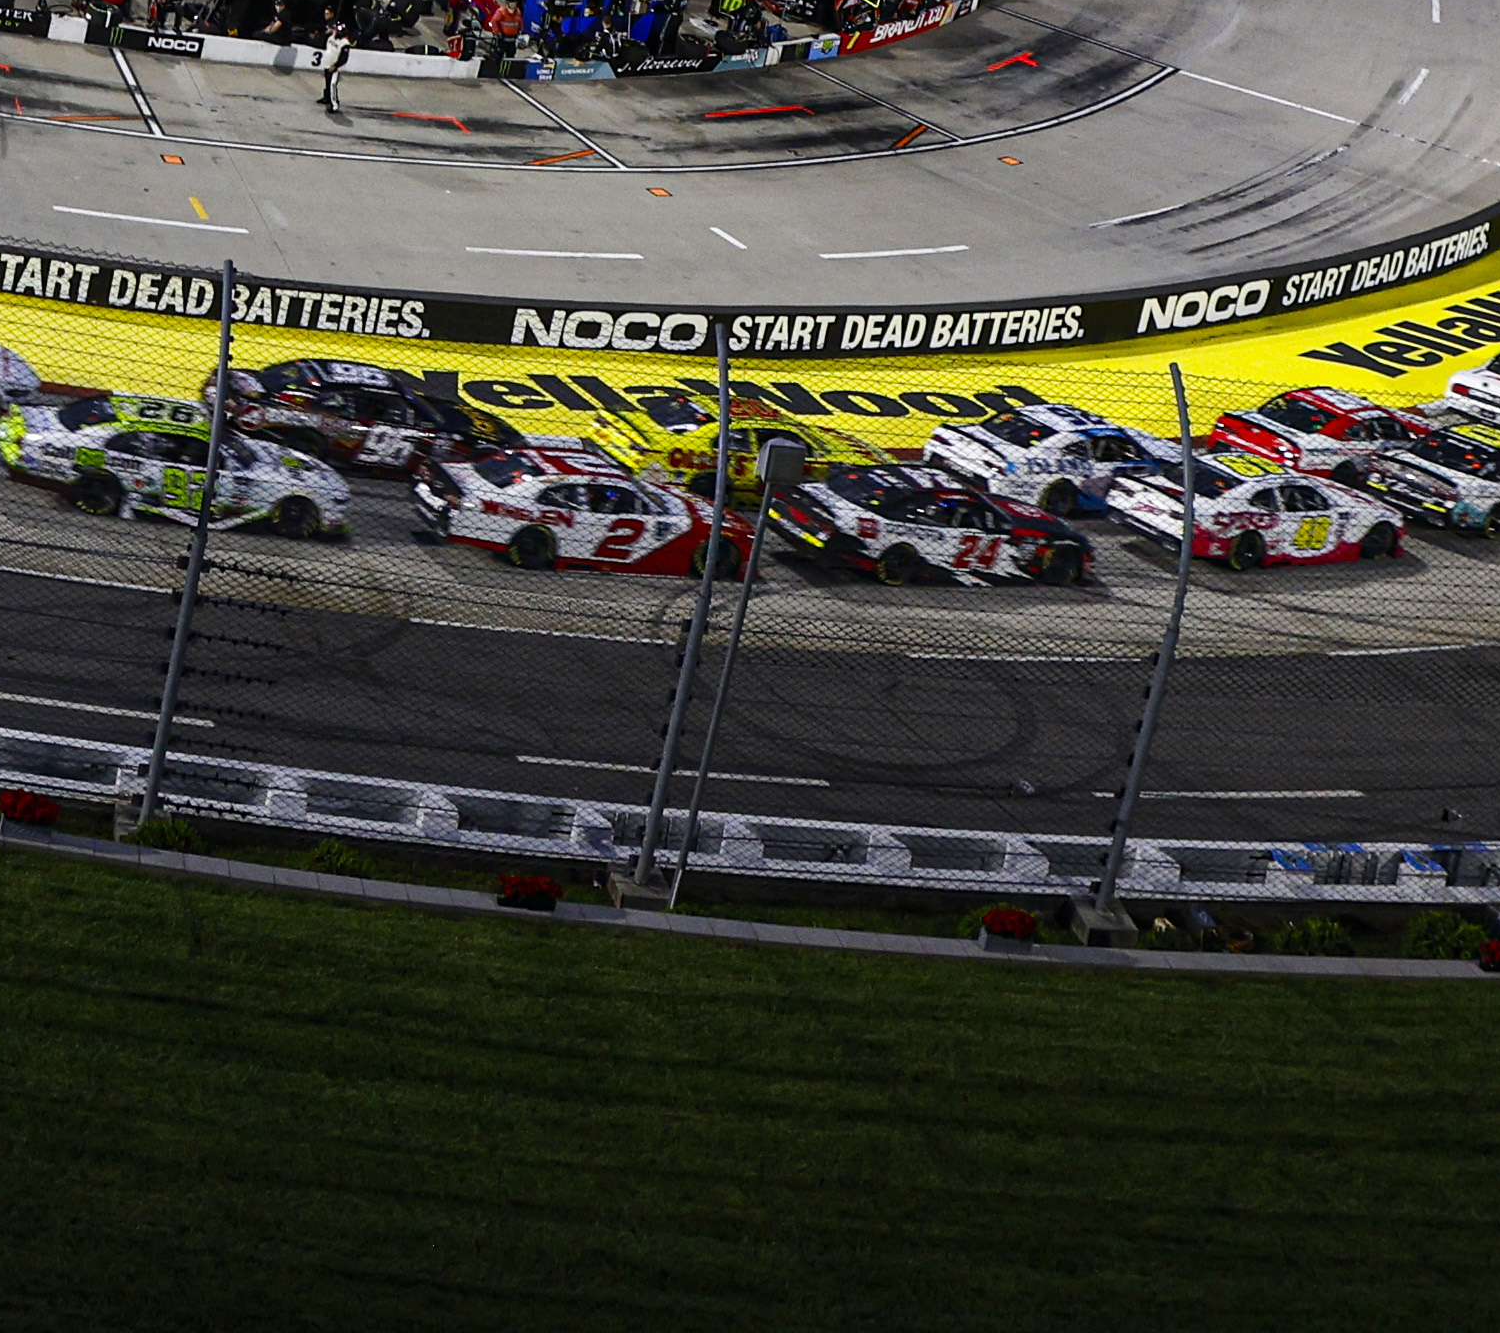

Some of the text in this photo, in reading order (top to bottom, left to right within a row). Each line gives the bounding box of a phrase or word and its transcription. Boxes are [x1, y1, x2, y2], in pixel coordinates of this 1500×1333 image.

[147, 36, 199, 53] NOCO
[846, 31, 861, 49] 7
[311, 51, 322, 67] 3
[108, 269, 215, 316] DEAD
[1137, 221, 1491, 334] NOCO START DEAD BATTERIES.
[510, 304, 1085, 352] NOCO START DEAD BATTERIES.
[594, 518, 645, 560] 2
[953, 536, 1002, 569] 24
